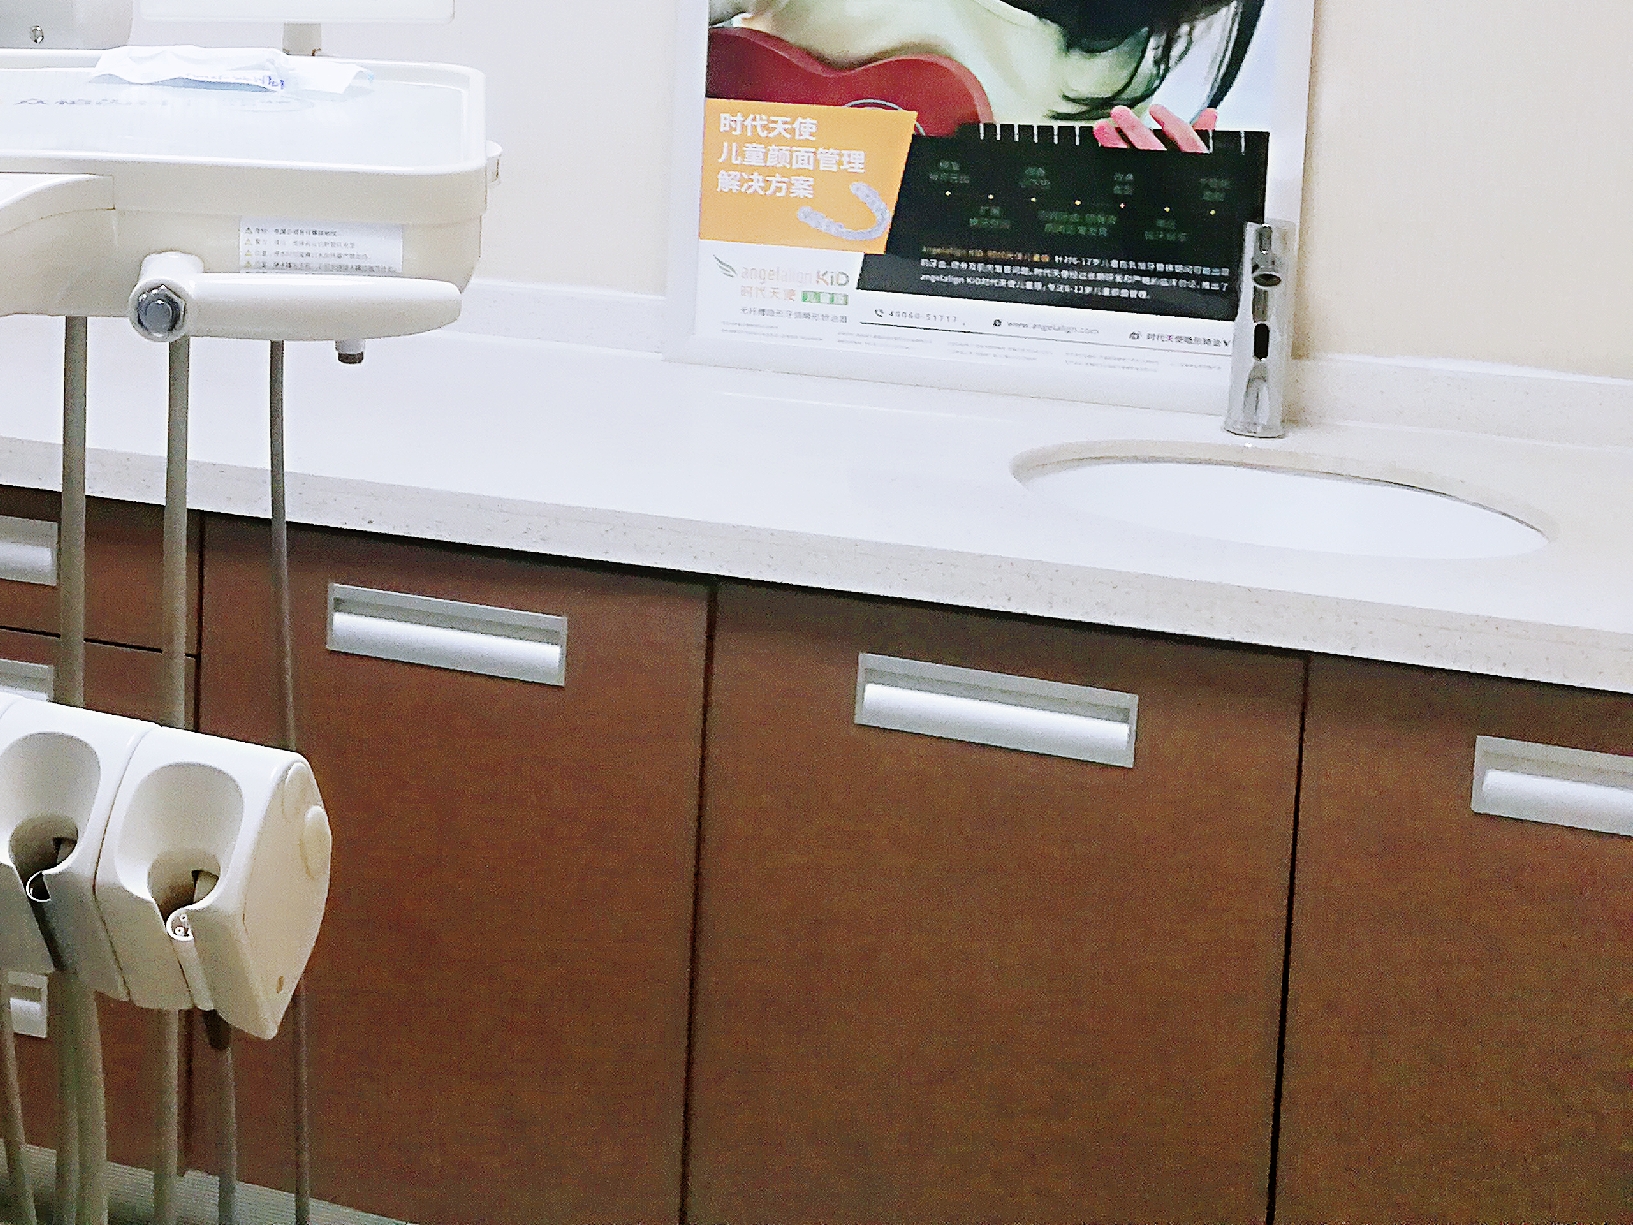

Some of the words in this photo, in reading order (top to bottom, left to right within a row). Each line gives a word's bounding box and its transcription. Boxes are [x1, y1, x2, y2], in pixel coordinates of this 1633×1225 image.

[719, 112, 818, 141] 时代天使
[718, 142, 866, 174] 儿童颜面管理
[717, 169, 815, 199] 解决方案
